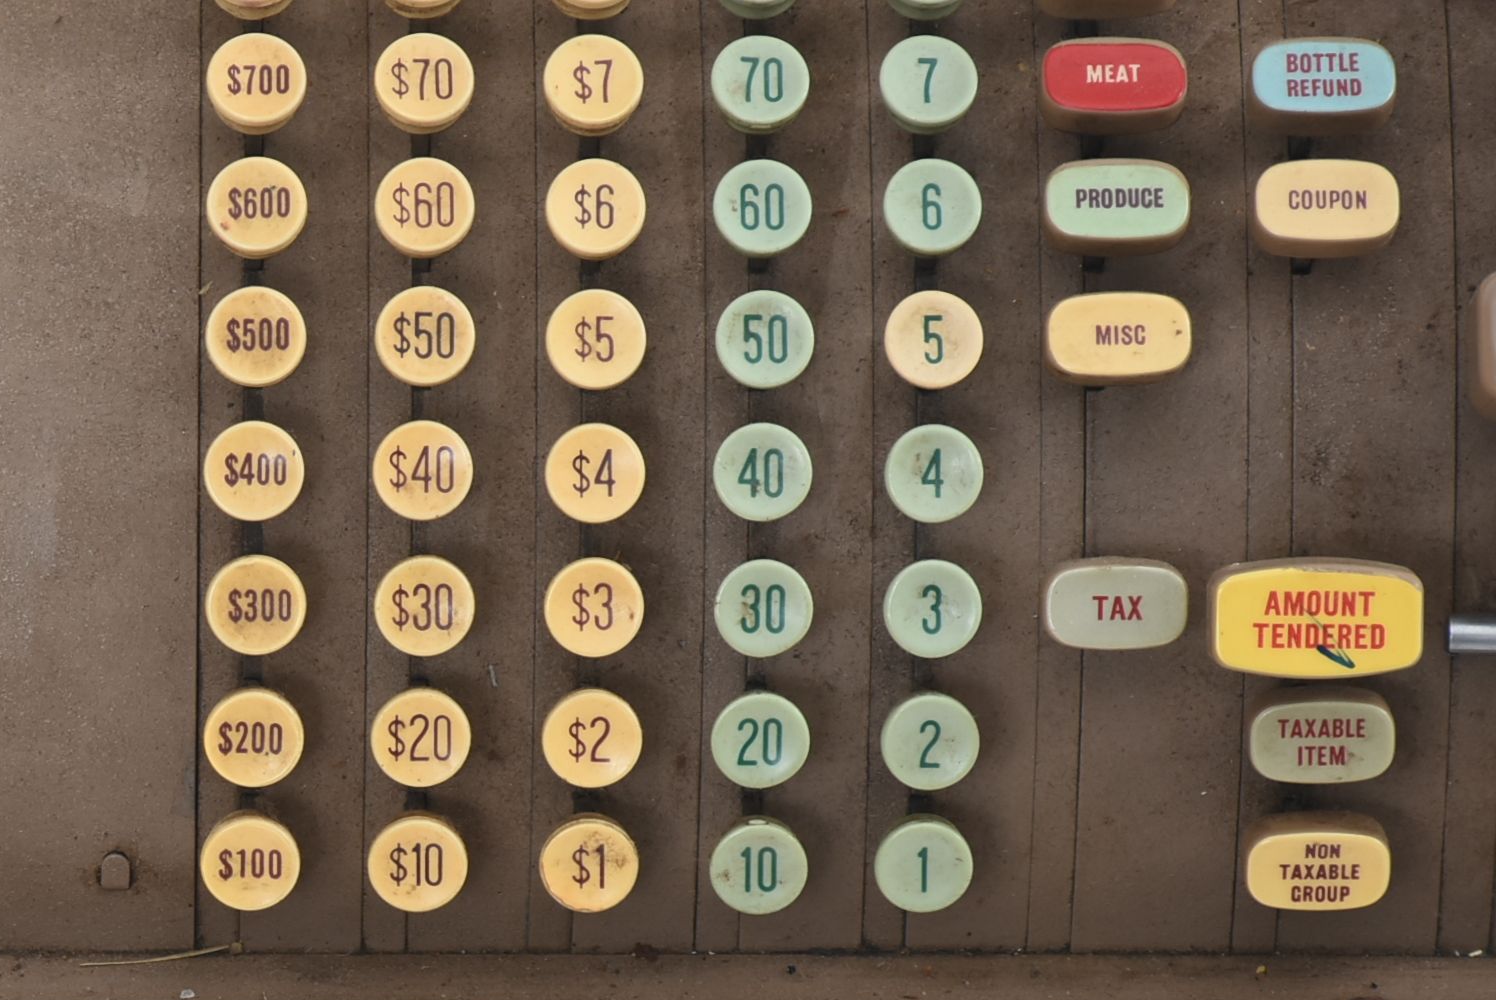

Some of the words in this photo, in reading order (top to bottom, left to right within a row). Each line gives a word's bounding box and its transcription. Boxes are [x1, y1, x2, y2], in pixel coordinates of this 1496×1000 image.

[228, 65, 290, 95] $700
[392, 58, 453, 100] $70
[573, 59, 614, 103] $7
[741, 57, 783, 102] 70
[918, 58, 937, 103] 7
[1086, 63, 1141, 84] MEAT
[1287, 53, 1359, 73] BOTTLE
[1287, 79, 1362, 96] REFUND
[228, 186, 291, 220] $600
[393, 182, 455, 228] $60
[575, 184, 615, 229] $6
[740, 184, 784, 230] 60
[922, 183, 942, 230] 6
[1076, 188, 1163, 208] PRODUCE
[1289, 190, 1368, 209] COUPON
[227, 318, 291, 352] $500
[394, 312, 456, 359] $50
[575, 316, 614, 362] $5
[744, 314, 787, 363] 50
[924, 315, 944, 364] 5
[1096, 325, 1147, 345] MISC
[225, 453, 288, 487] $400
[390, 446, 457, 493] $40
[573, 449, 616, 497] $4
[738, 448, 783, 497] 40
[921, 449, 943, 497] 4
[229, 589, 292, 623] $300
[393, 584, 454, 631] $30
[573, 582, 615, 631] $3
[740, 584, 785, 633] 30
[922, 585, 942, 634] 3
[1093, 596, 1142, 620] TAX
[1265, 591, 1375, 616] AMOUNT
[1253, 623, 1385, 650] TENDERED
[219, 722, 283, 755] $200
[388, 714, 452, 761] $20
[569, 716, 614, 765] $2
[737, 718, 782, 766] 20
[920, 720, 941, 768] 2
[1278, 719, 1365, 738] TAXABLE
[1298, 746, 1347, 766] ITEM
[219, 849, 282, 880] $100
[390, 843, 443, 886] $10
[572, 844, 605, 888] $1
[741, 847, 777, 892] 10
[918, 847, 927, 892] 1
[1280, 864, 1359, 880] TAXABLE
[1305, 844, 1341, 859] NON
[1292, 886, 1351, 902] GROUP
